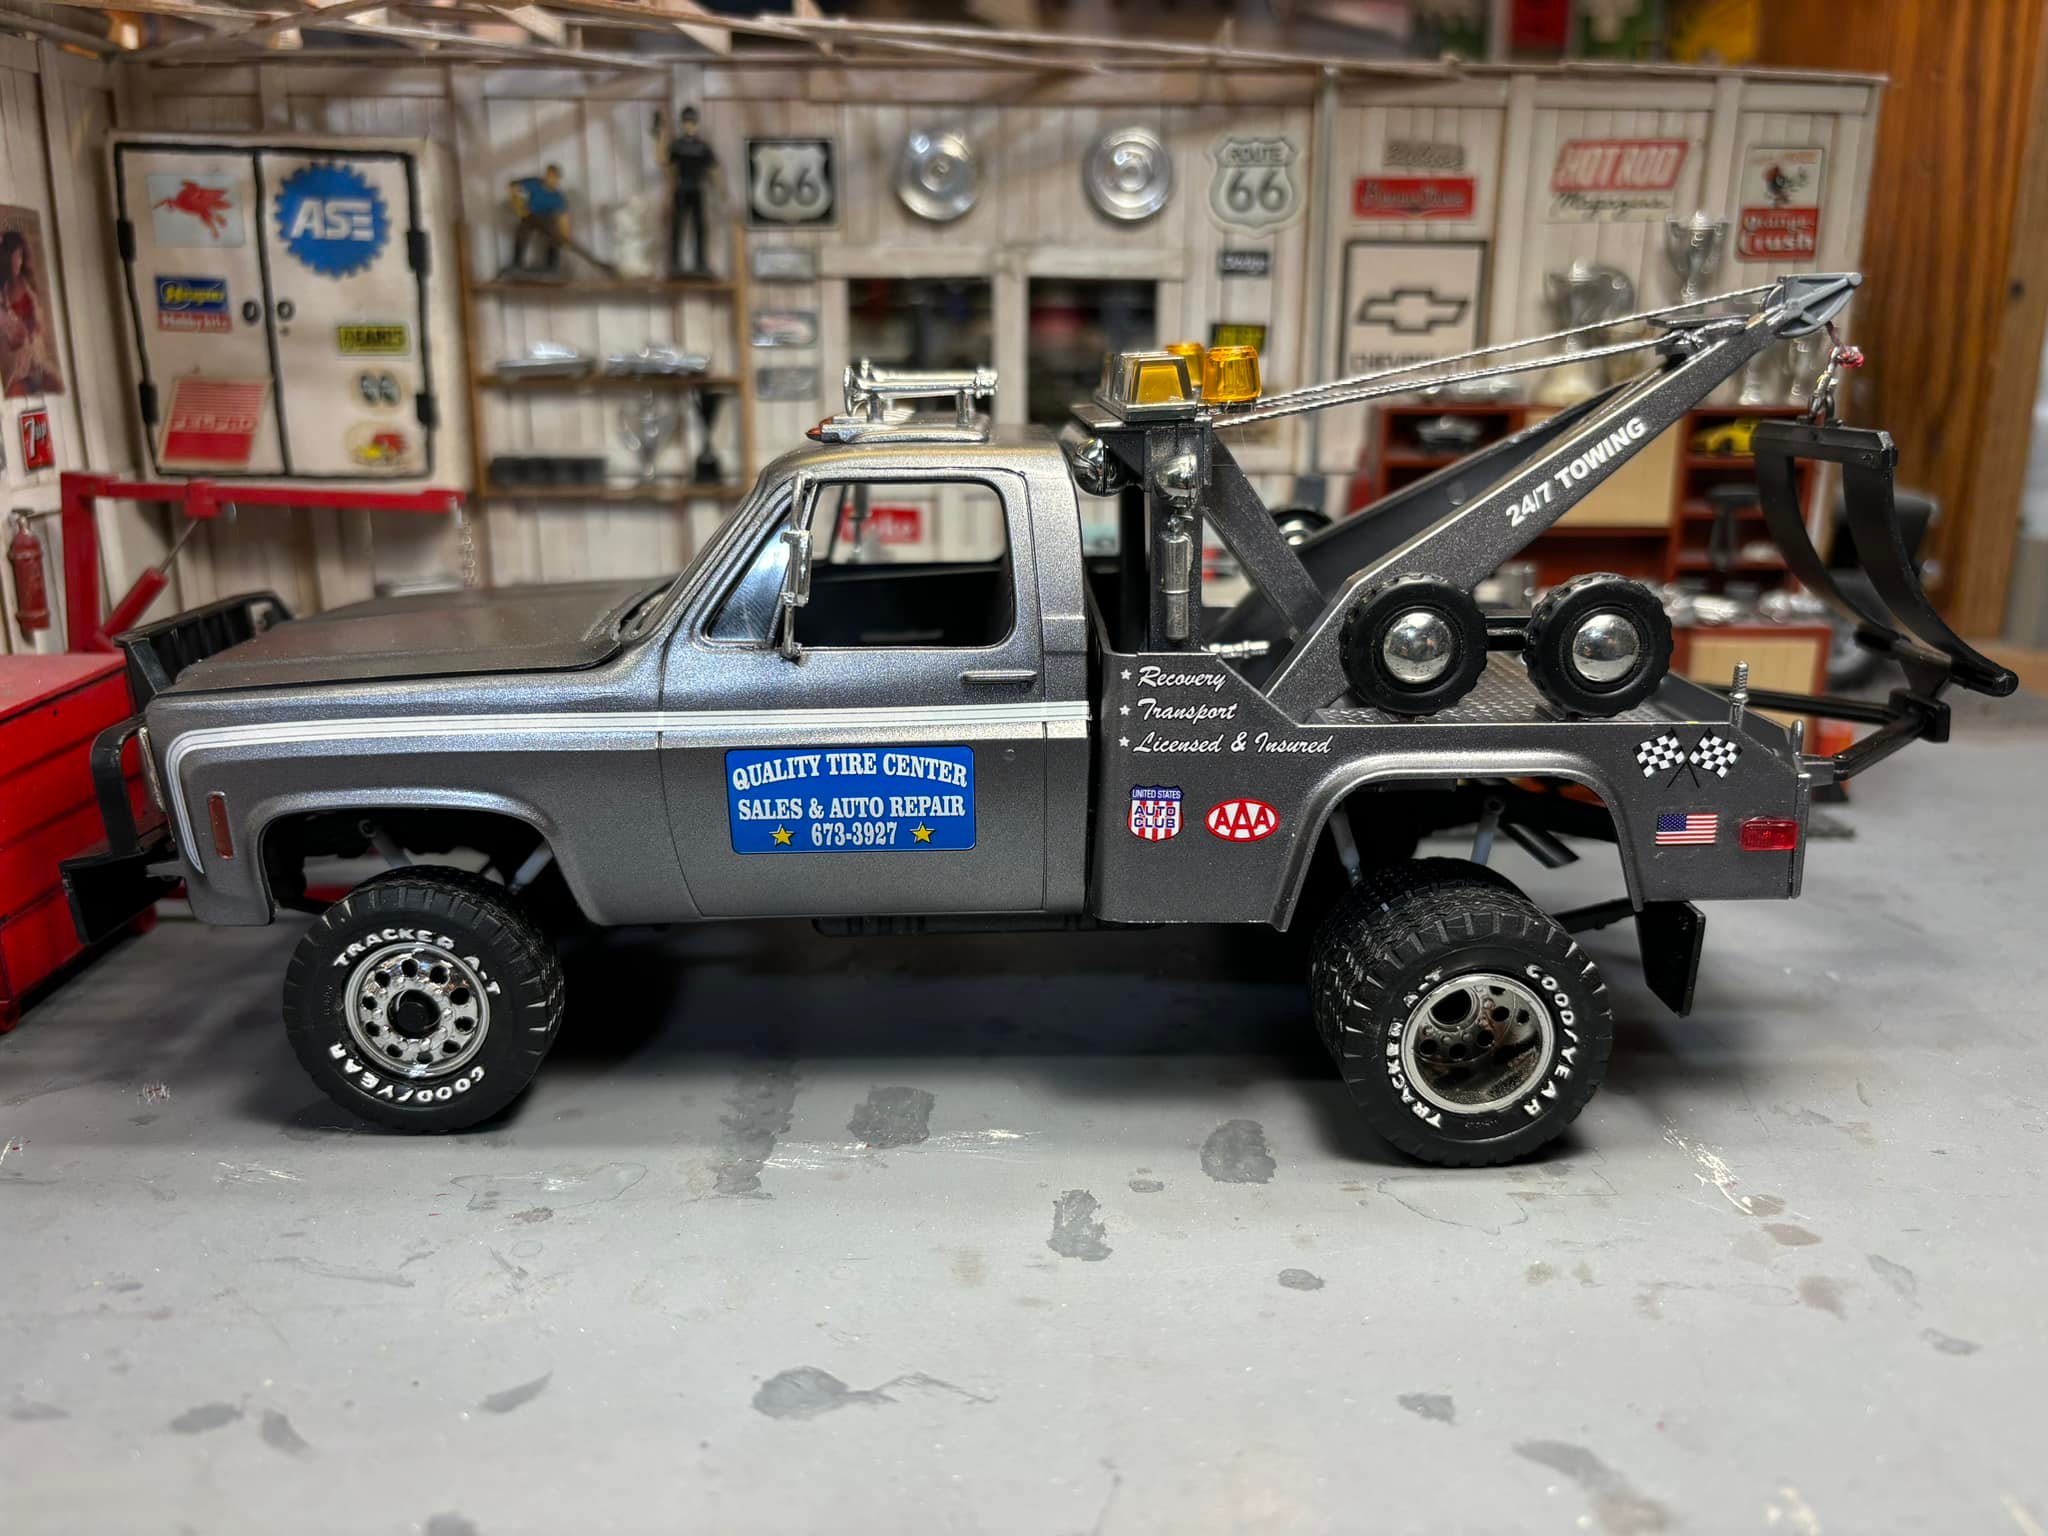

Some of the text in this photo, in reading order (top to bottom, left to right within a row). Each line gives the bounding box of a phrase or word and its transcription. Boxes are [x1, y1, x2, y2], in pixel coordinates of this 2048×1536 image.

[1229, 146, 1283, 162] ROUTE
[1556, 145, 1678, 187] HOT ROD
[768, 166, 822, 208] 66
[1227, 170, 1286, 213] 66
[291, 199, 375, 242] ASE
[1737, 233, 1813, 256] Crush
[1505, 417, 1648, 527] 24/7 TOWING
[1137, 666, 1227, 692] Recovery
[1137, 698, 1239, 725] Transport
[1132, 731, 1334, 754] Licensed & Insured
[732, 753, 968, 791] QUALITY TIRE CENTER
[737, 795, 966, 820] SALES & AUTO REPAIR
[1132, 788, 1181, 800] UNITED STATES
[1134, 805, 1176, 816] AUTO
[1134, 817, 1176, 828] CLUB
[1212, 801, 1274, 840] AAA
[811, 822, 898, 847] 673-3927
[332, 927, 456, 968] TRACKER
[1523, 964, 1579, 1117] GOODYEAR
